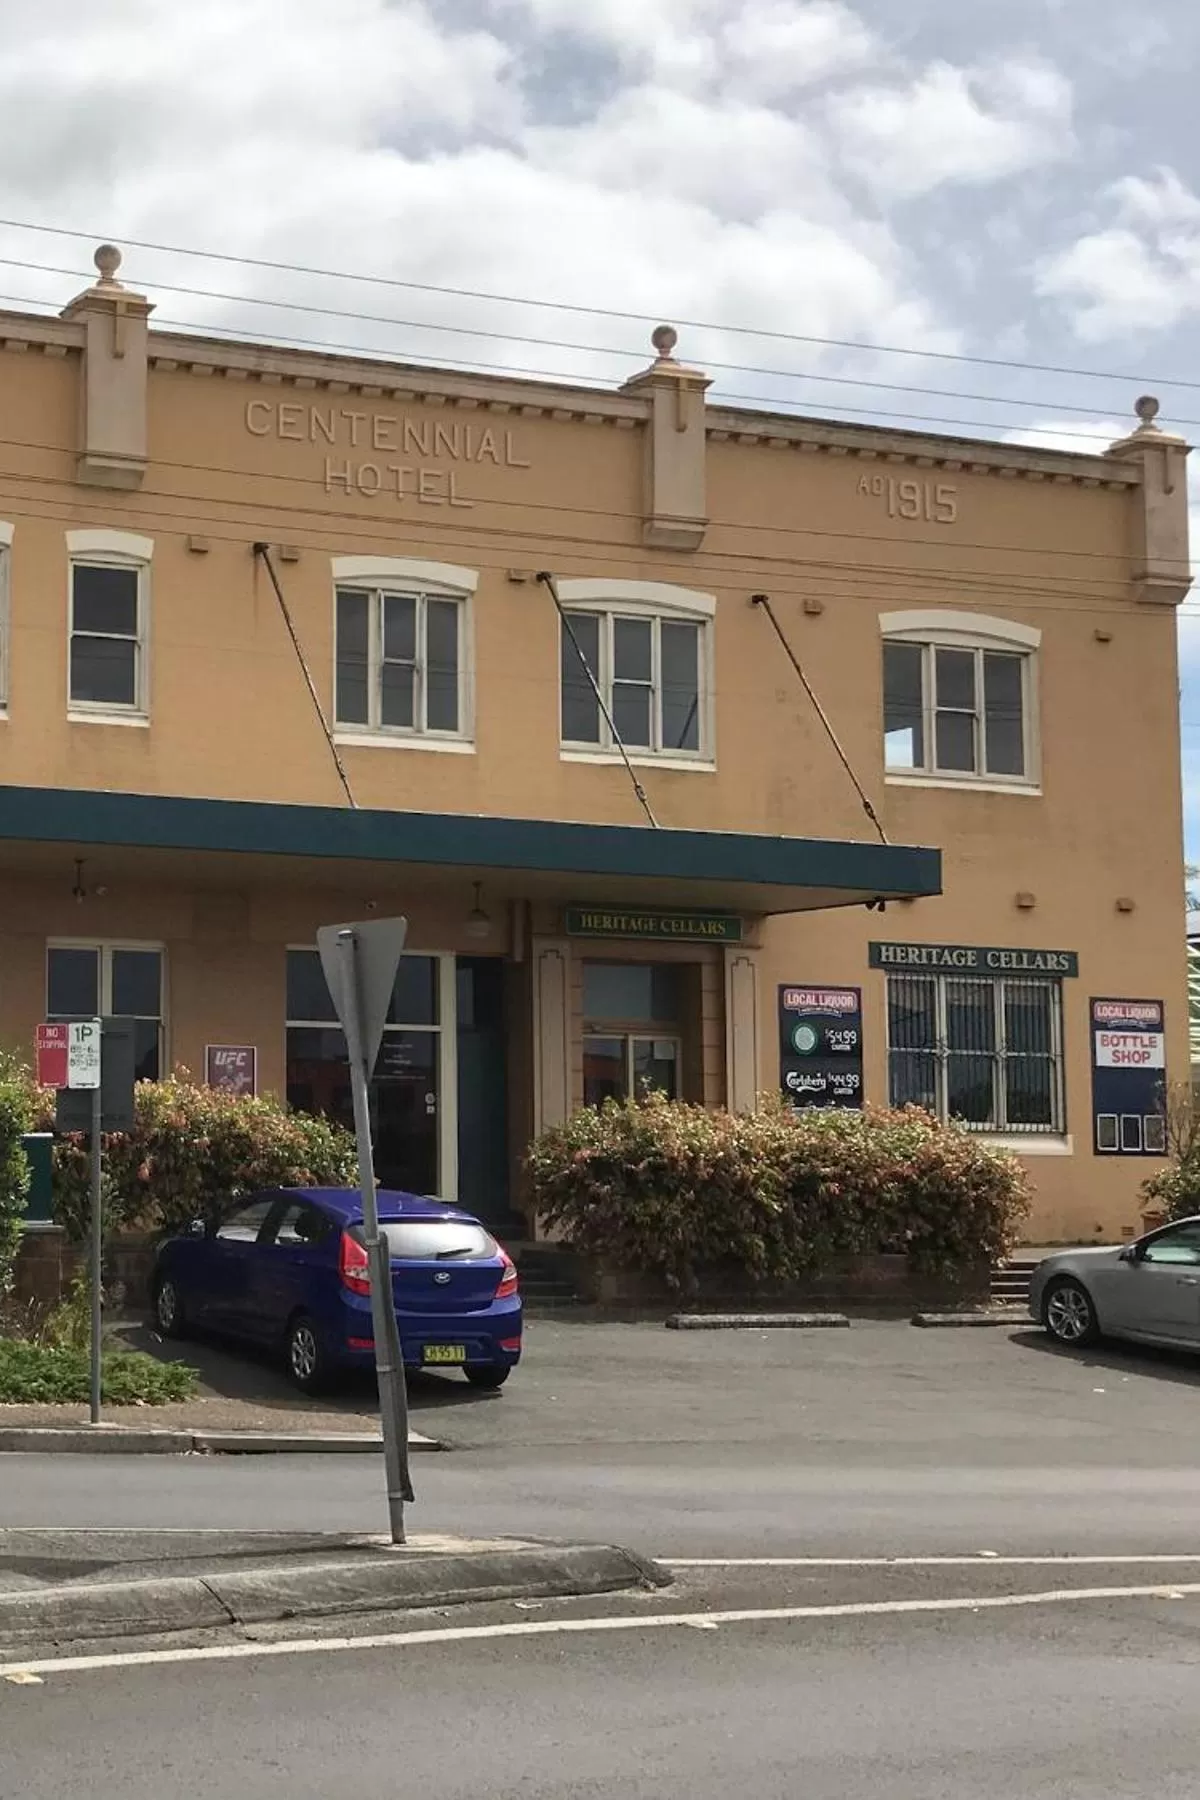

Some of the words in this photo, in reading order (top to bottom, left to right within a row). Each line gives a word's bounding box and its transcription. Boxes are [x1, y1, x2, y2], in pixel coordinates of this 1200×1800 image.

[244, 400, 531, 467] CENTENNIAL
[324, 456, 475, 509] HOTEL
[886, 477, 957, 524] 1915
[581, 913, 657, 933] HERITAGE
[659, 918, 726, 936] CELLARS
[879, 945, 978, 967] HERITAGE
[986, 951, 1069, 971] CELLARS
[787, 993, 818, 1006] LOCAL
[819, 994, 854, 1008] LIQUOR
[1097, 1005, 1125, 1018] LOCAL
[1126, 1007, 1157, 1019] LIQUOR
[45, 1027, 59, 1038] NO
[75, 1024, 93, 1042] 1P
[1101, 1034, 1157, 1049] BOTTLE
[214, 1051, 247, 1066] UFC
[1112, 1049, 1151, 1064] SHOP
